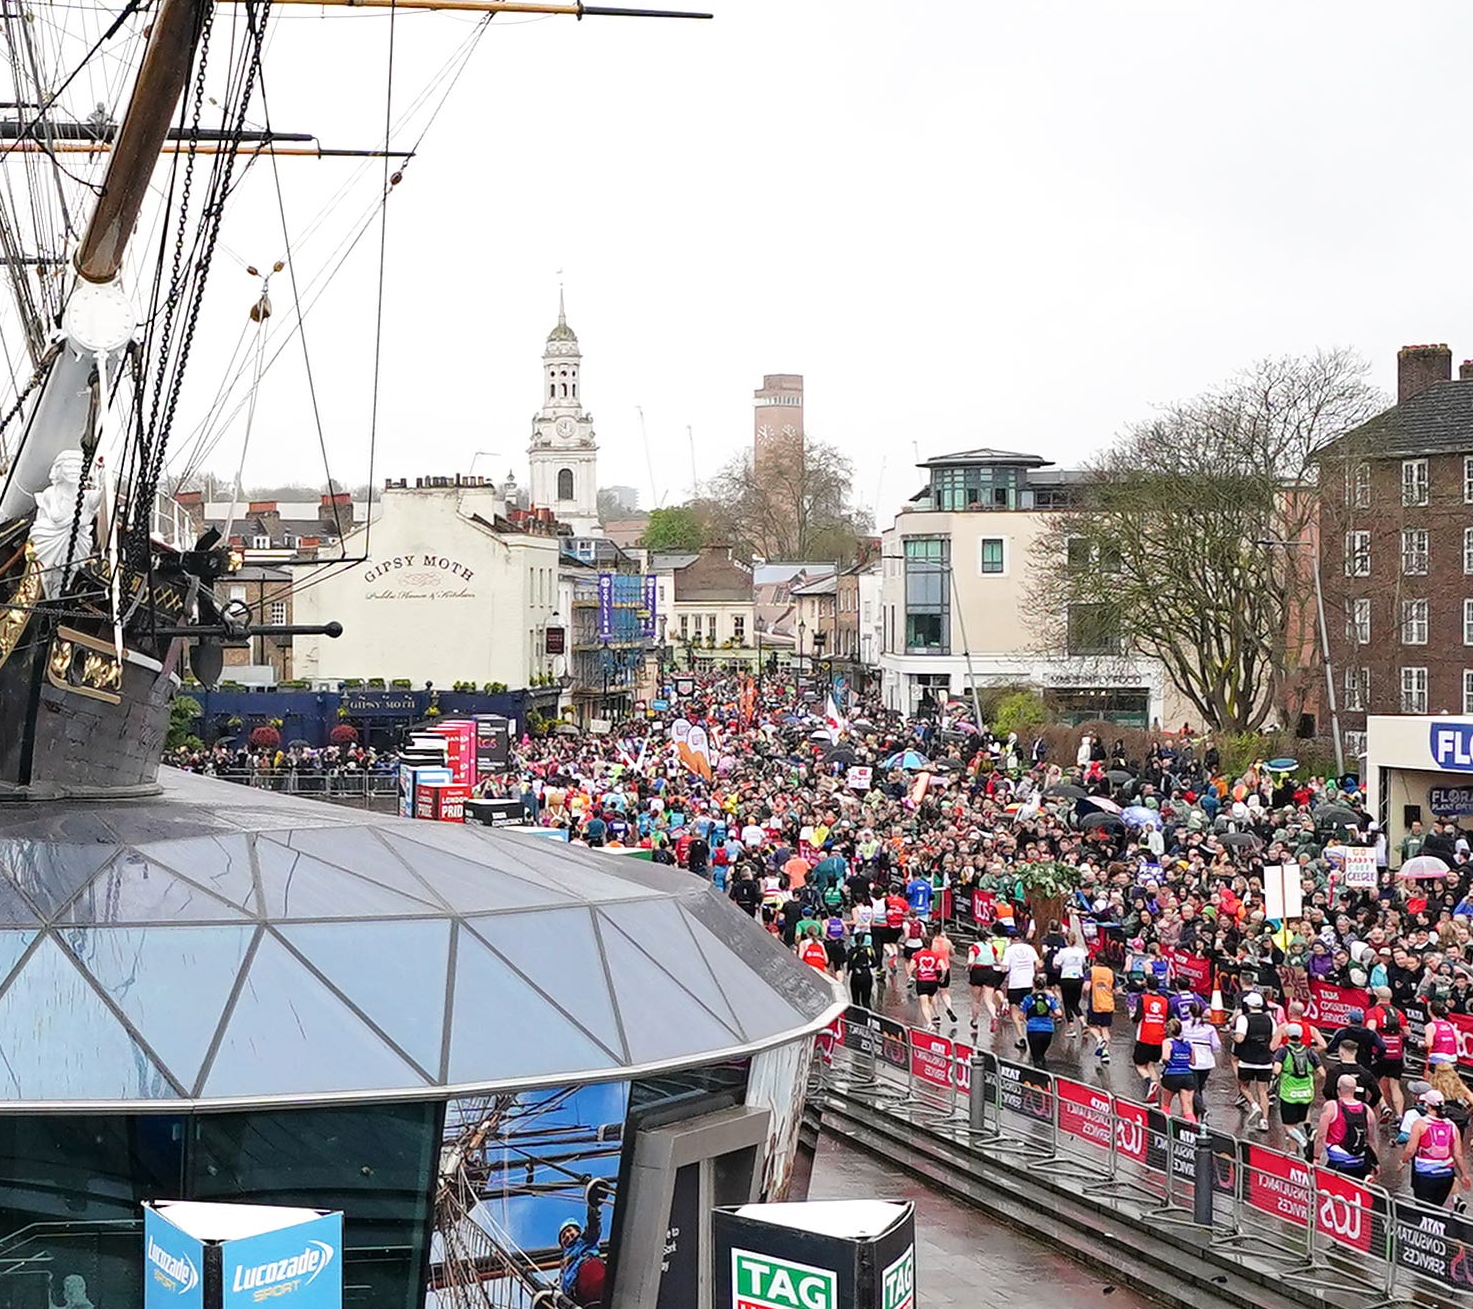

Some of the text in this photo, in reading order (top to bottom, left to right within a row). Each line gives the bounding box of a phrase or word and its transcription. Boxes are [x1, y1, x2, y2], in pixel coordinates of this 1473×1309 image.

[363, 554, 474, 584] GIPSY MOTH
[232, 1247, 320, 1294] Lucozade
[885, 1263, 914, 1308] TAG
[252, 1280, 302, 1303] SPORT
